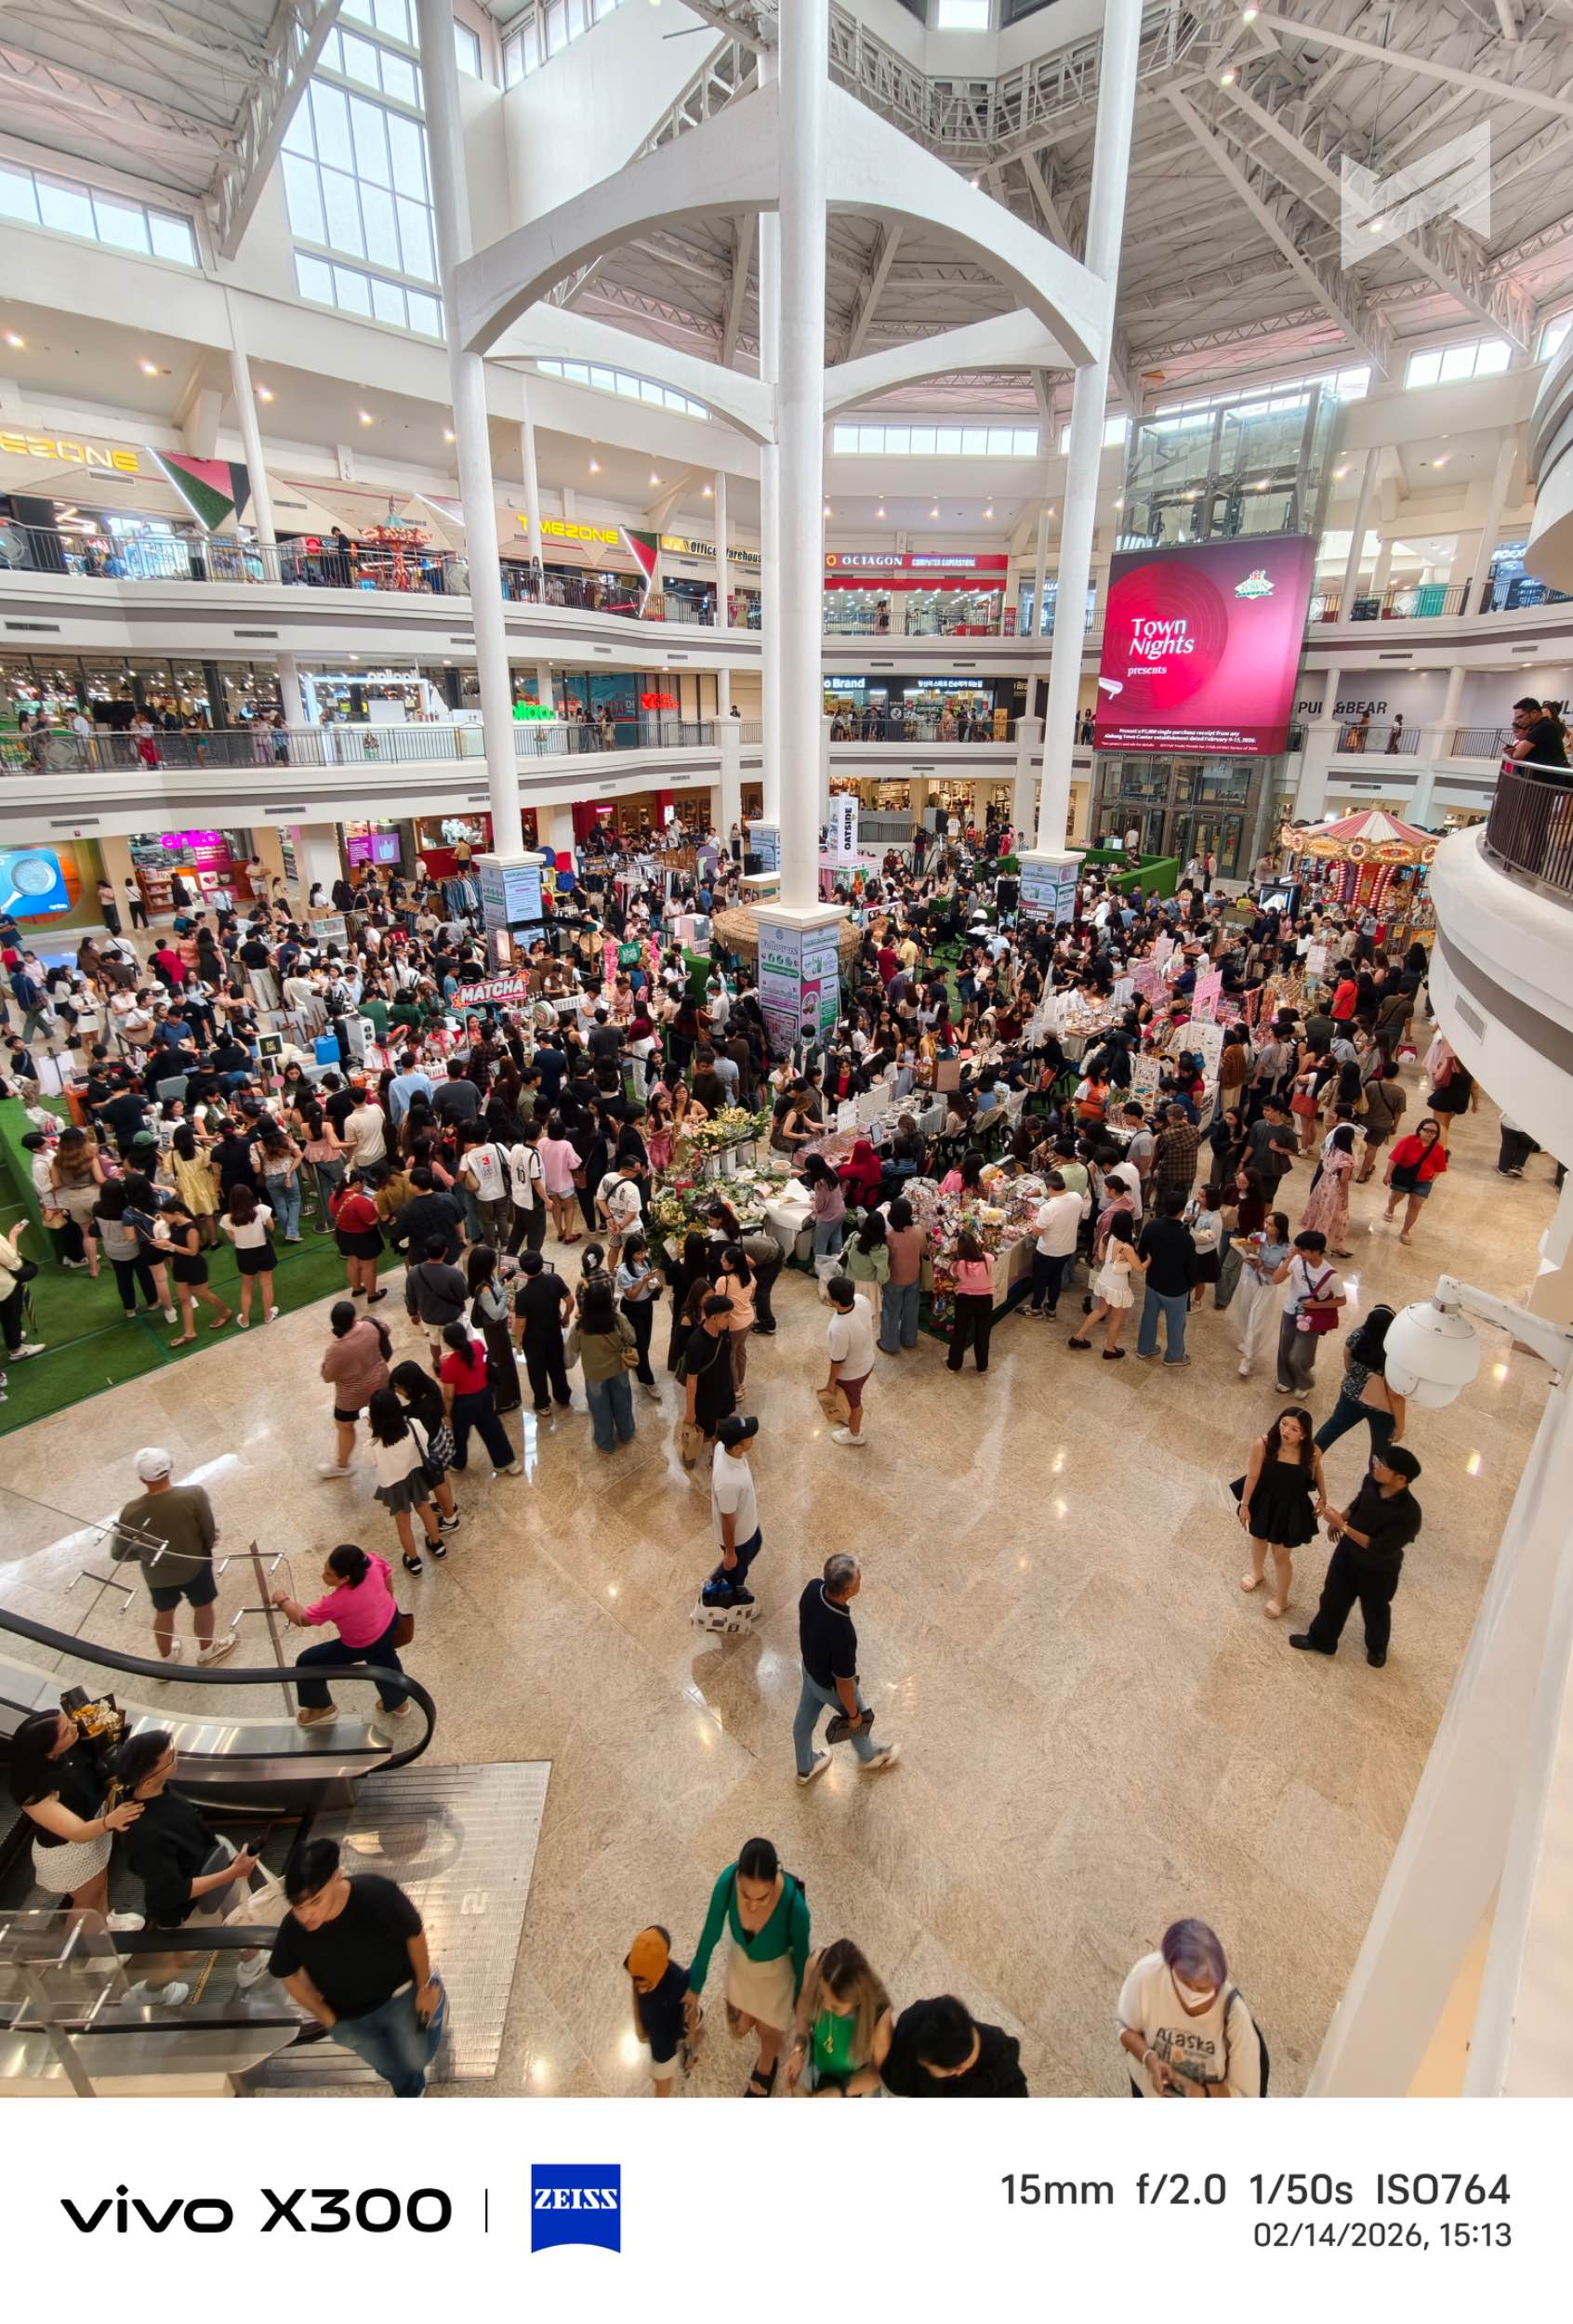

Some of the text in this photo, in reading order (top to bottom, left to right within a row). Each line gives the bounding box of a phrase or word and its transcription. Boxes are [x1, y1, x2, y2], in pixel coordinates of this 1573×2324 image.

[517, 514, 618, 545] TMEZONE
[726, 548, 761, 562] arehous
[842, 556, 903, 565] OCTAGON
[1131, 618, 1186, 639] Town
[1130, 636, 1195, 660] Nights
[1128, 667, 1167, 677] presents
[832, 678, 865, 688] Brand
[844, 807, 853, 850] OATSIDE
[461, 978, 523, 1002] MATCHA
[482, 1155, 490, 1165] 3
